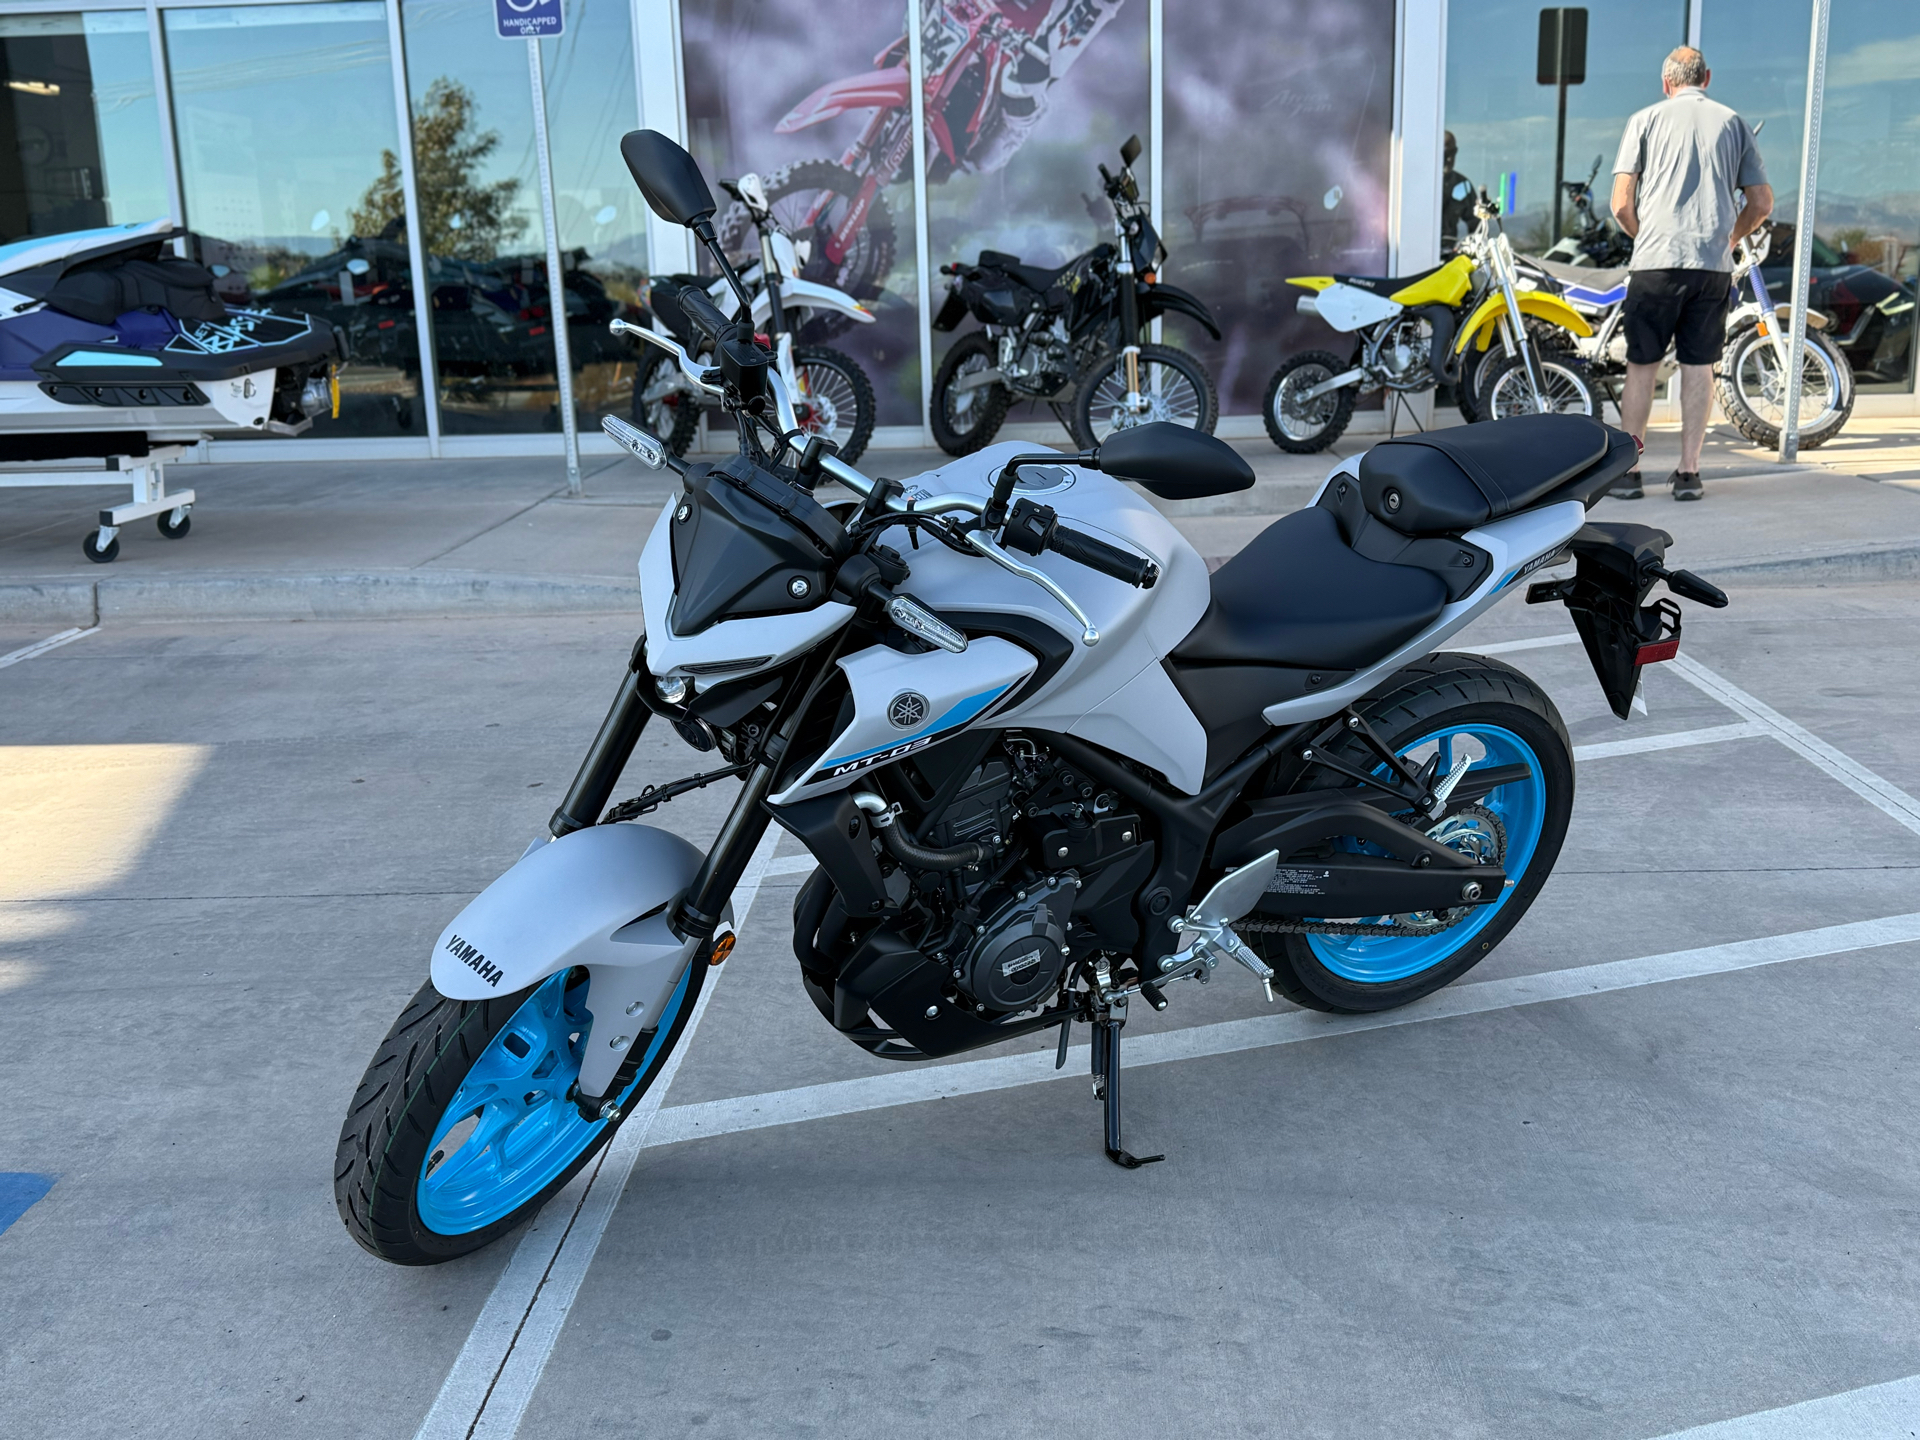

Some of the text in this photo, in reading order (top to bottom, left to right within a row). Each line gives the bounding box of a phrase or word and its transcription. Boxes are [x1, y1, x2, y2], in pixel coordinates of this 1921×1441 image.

[503, 16, 557, 27] HANDICAPPED
[520, 25, 541, 35] ONLY
[839, 198, 866, 242] DUNLOP
[1348, 277, 1376, 288] SUZUKI
[1524, 549, 1556, 574] YAMAHA
[832, 736, 933, 777] MT-03
[445, 934, 504, 988] YAMAHA
